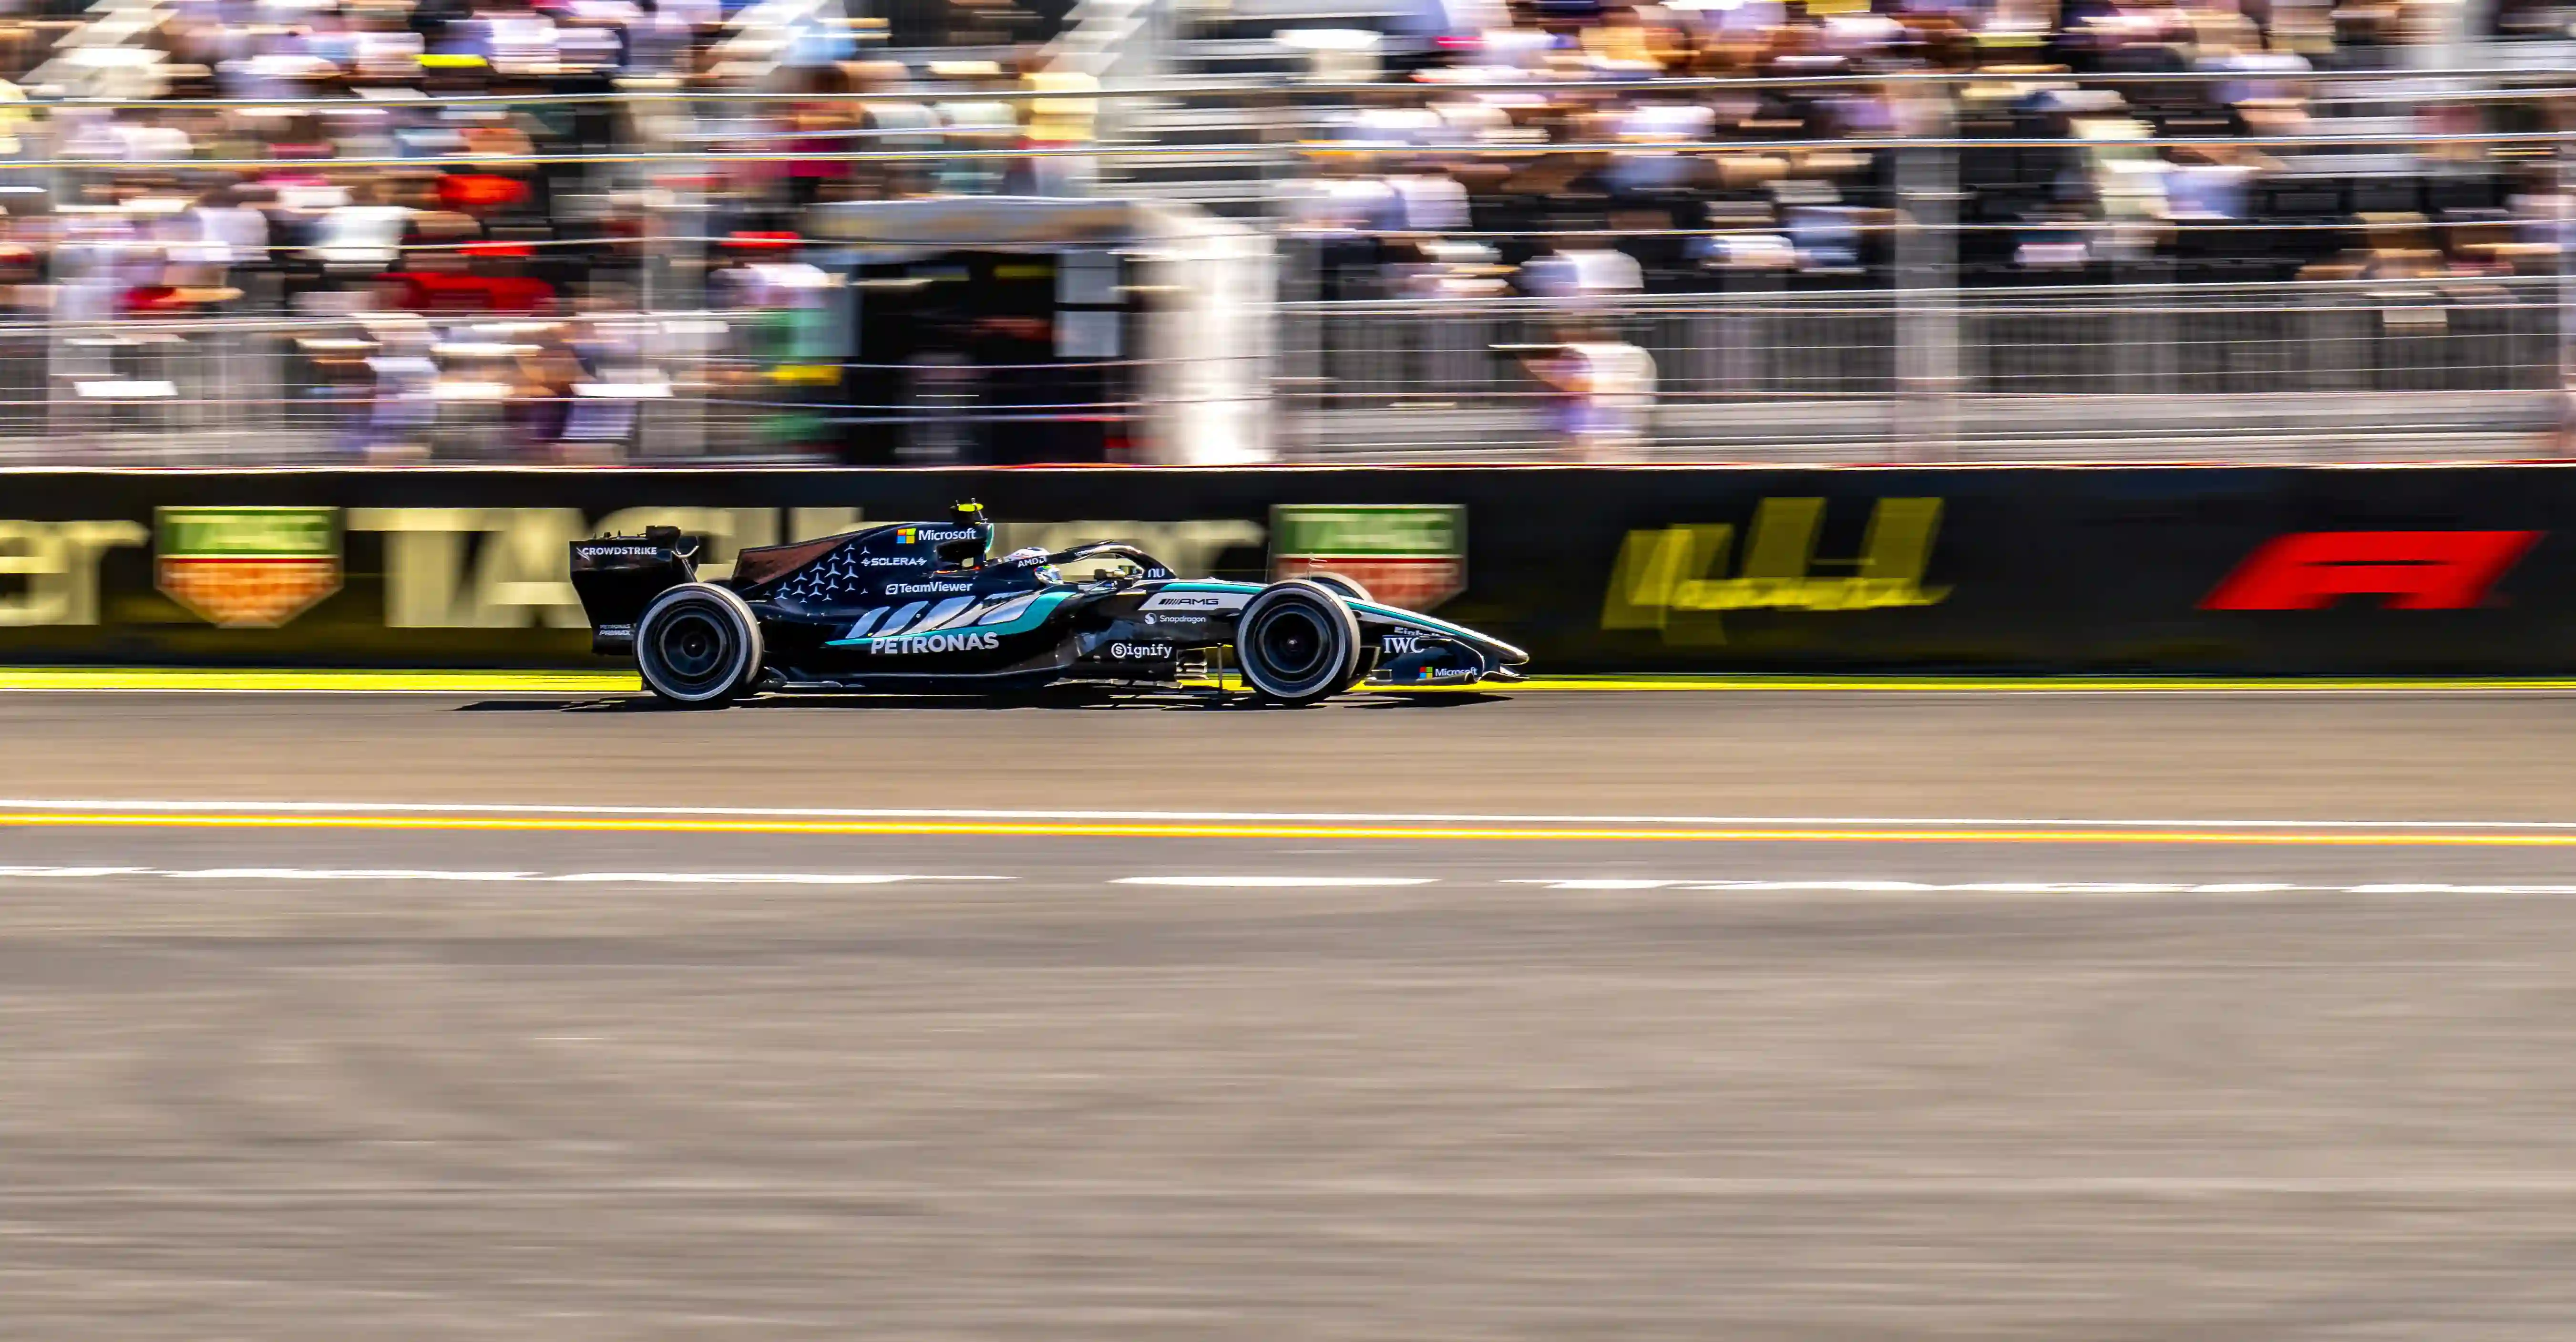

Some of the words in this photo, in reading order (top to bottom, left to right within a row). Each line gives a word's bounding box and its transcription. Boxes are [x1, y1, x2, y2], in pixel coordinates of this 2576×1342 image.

[919, 528, 976, 540] Microsoft
[583, 547, 657, 555] CROWDSTRIKE
[871, 557, 917, 566] SOLERA
[1018, 557, 1038, 568] AMD
[899, 582, 973, 593] TeamViewer
[1160, 615, 1206, 624] Snapdragon
[871, 632, 999, 654] PETRONAS
[1384, 637, 1425, 653] IWC
